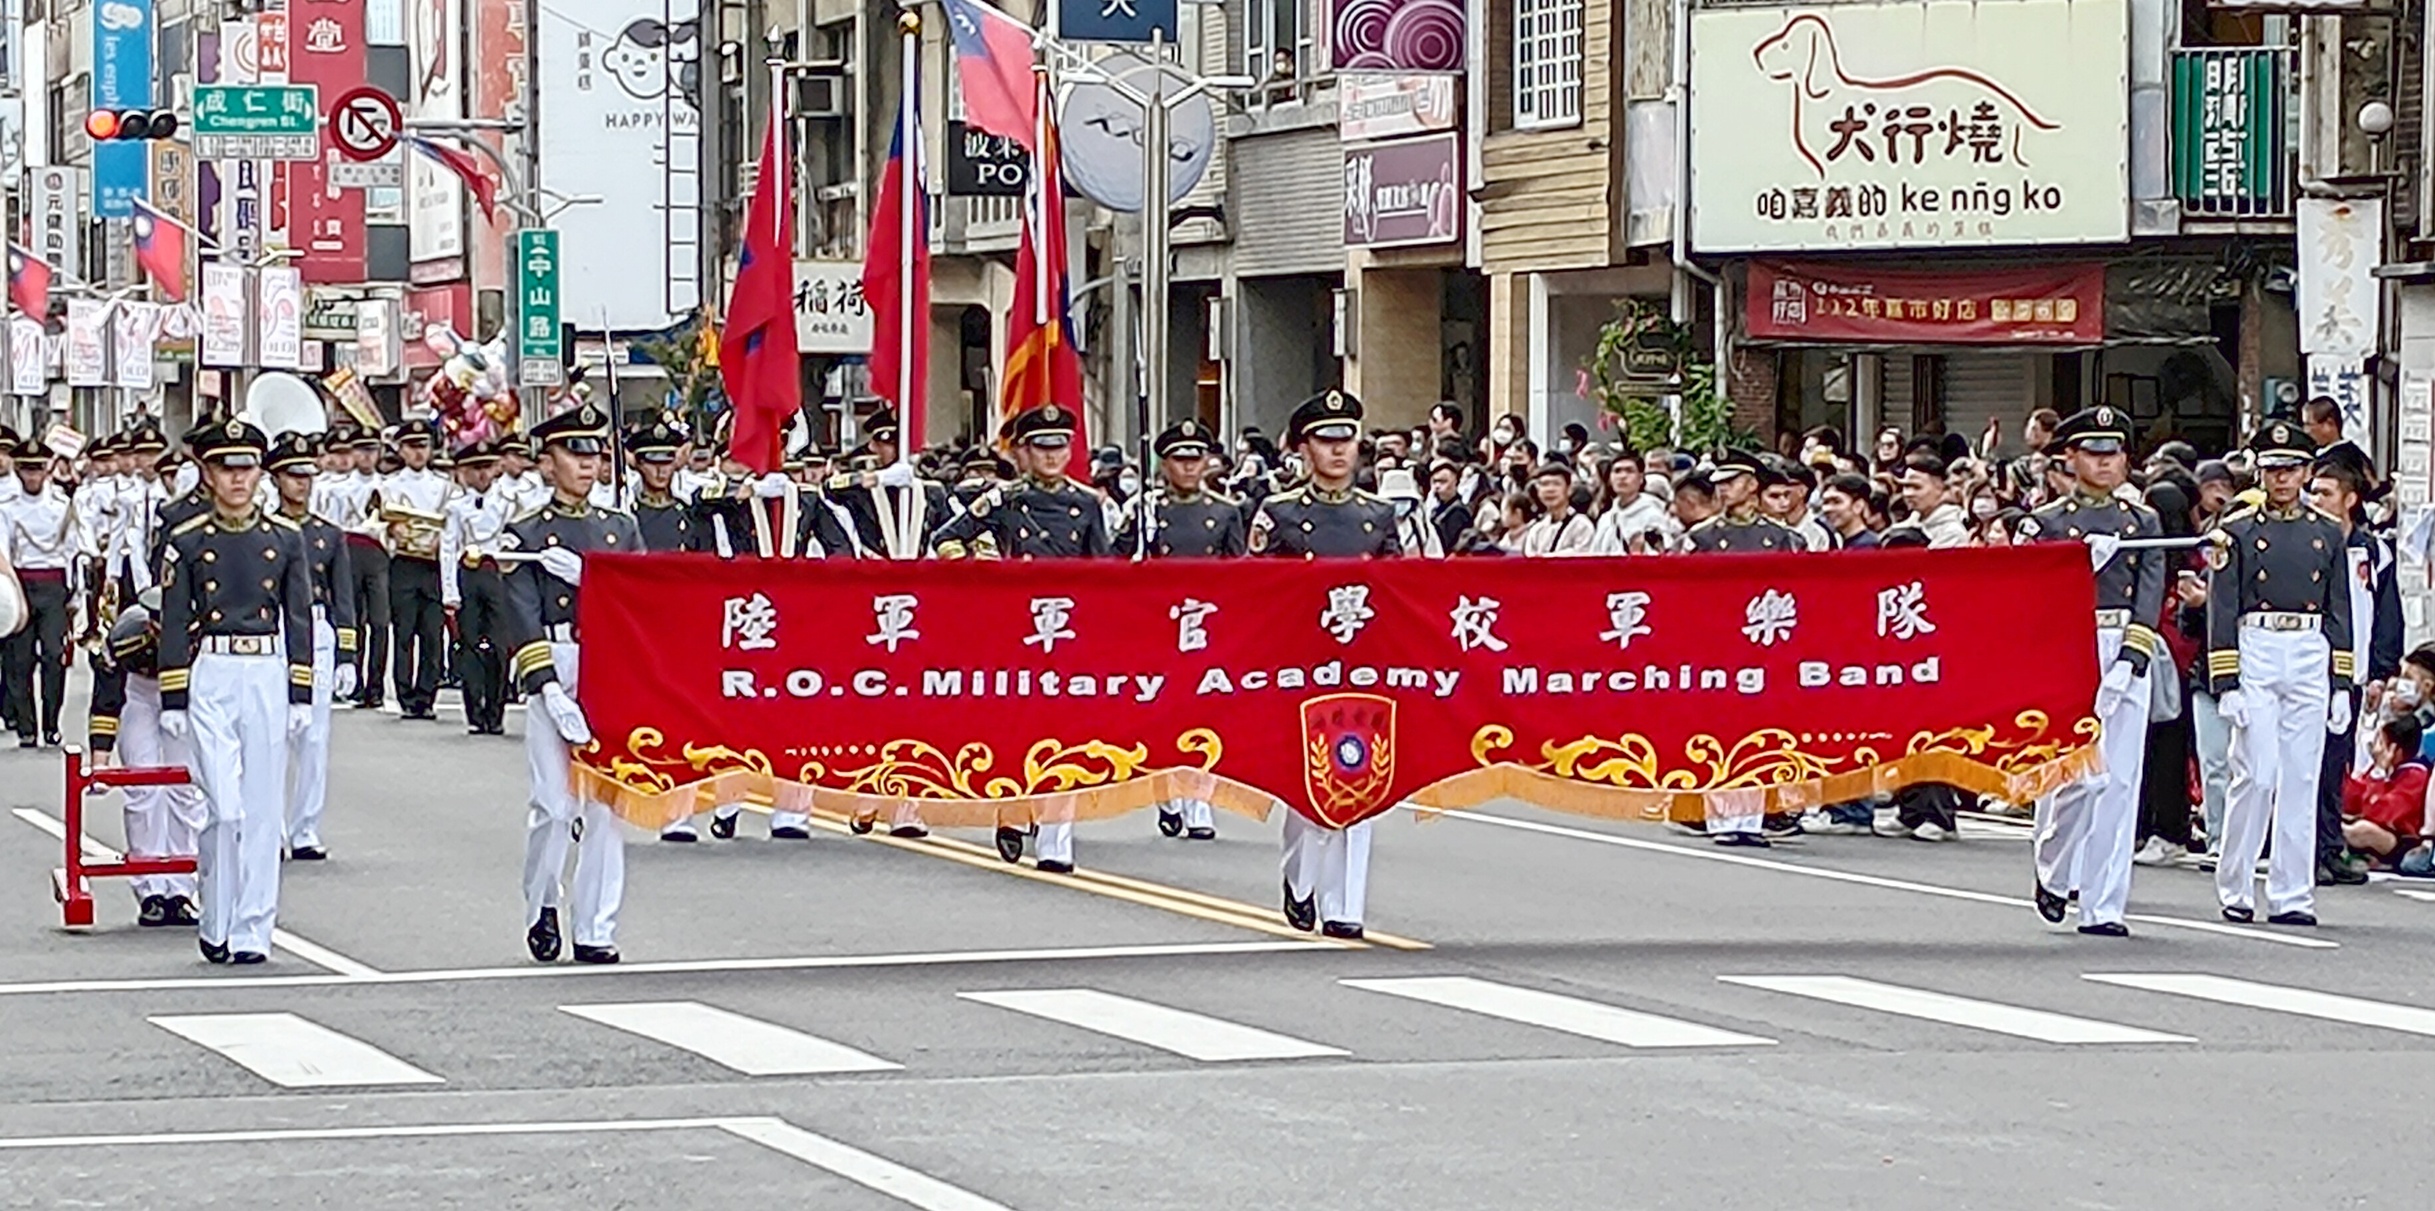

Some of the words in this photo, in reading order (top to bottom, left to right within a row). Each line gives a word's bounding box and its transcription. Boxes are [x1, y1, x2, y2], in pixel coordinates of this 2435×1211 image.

[205, 89, 305, 114] 成仁街
[209, 114, 279, 130] Chengren
[605, 112, 665, 128] HAPPY
[1826, 100, 2003, 165] 犬行燒
[1757, 185, 1888, 220] 咱嘉義的
[1902, 182, 1940, 212] ke
[2023, 179, 2062, 210] ko
[527, 254, 552, 338] 中山路
[722, 585, 1937, 654] 陸軍軍官學校軍樂隊
[1196, 660, 1460, 697] Academy
[1502, 665, 1765, 694] Marching
[1799, 656, 1939, 687] Band
